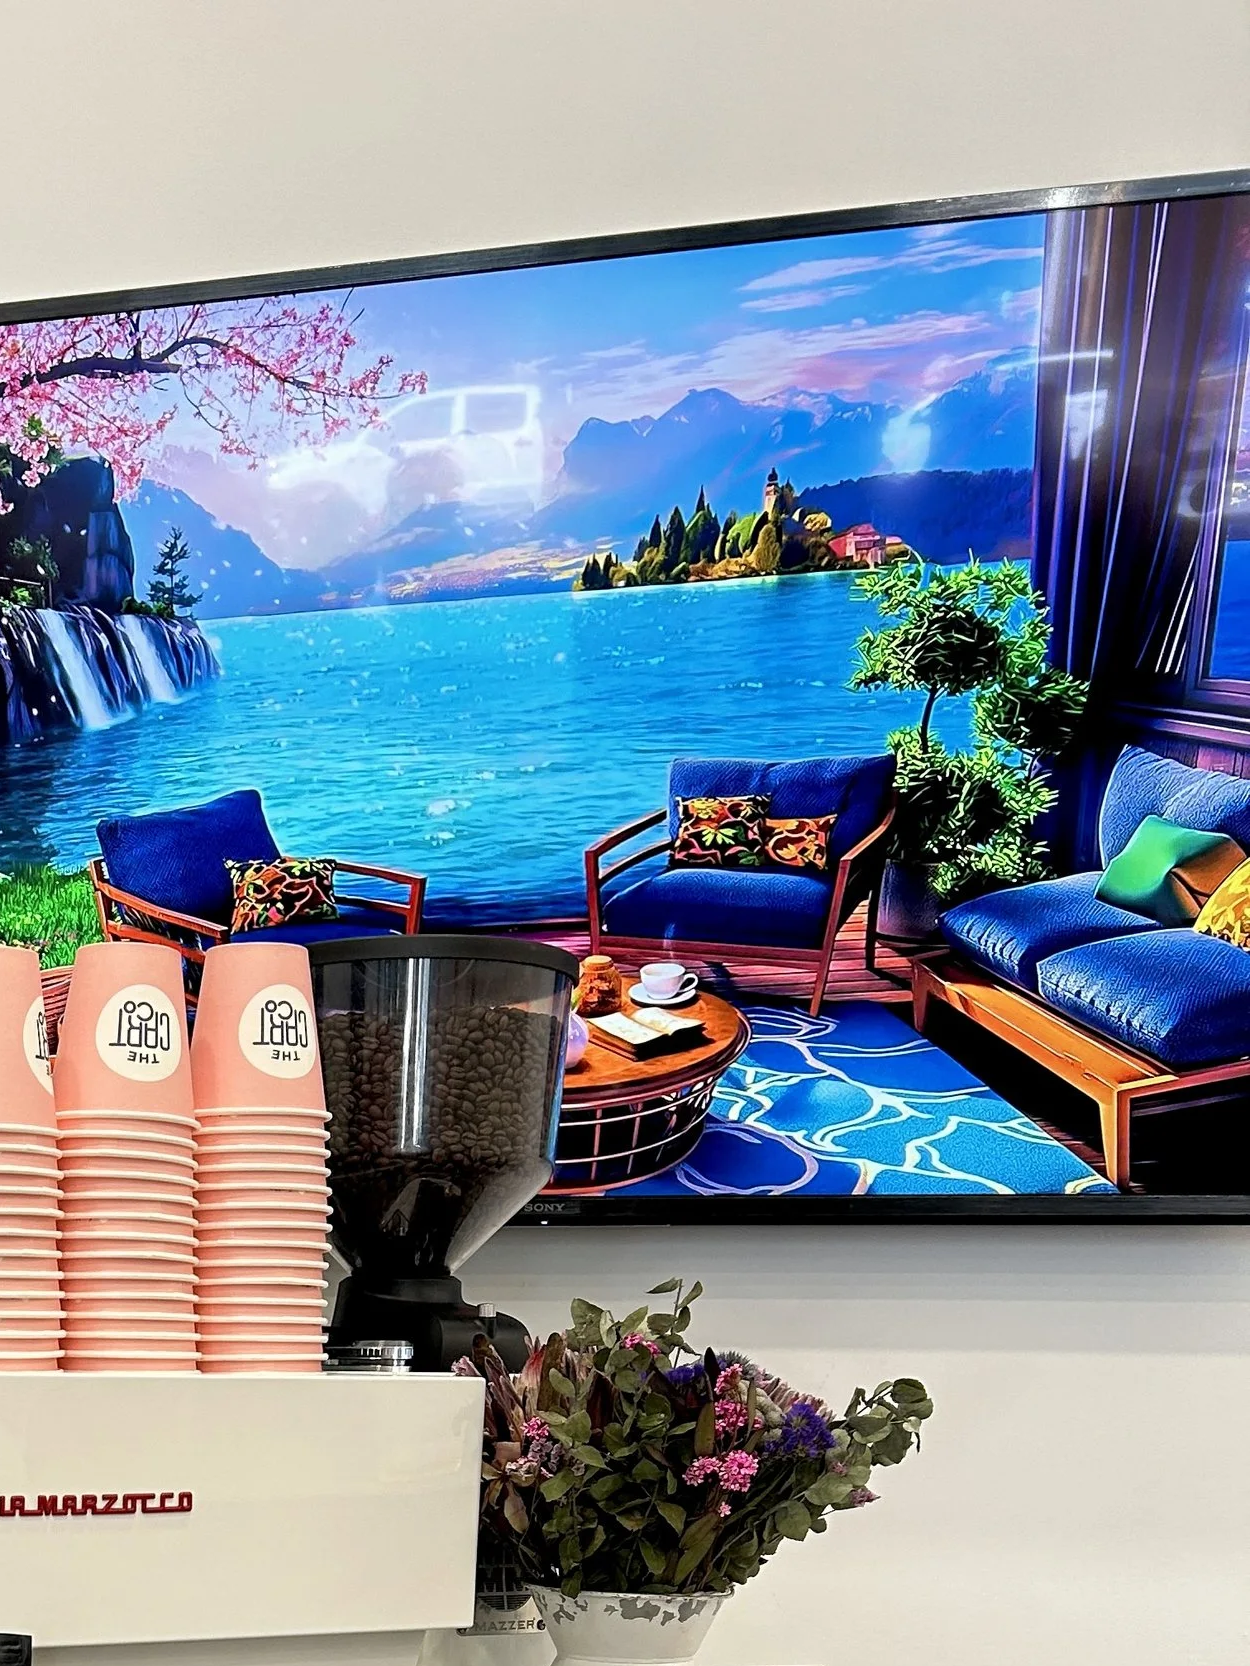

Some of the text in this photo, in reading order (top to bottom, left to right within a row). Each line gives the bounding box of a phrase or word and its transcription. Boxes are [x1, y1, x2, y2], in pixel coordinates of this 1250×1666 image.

[123, 1000, 154, 1022] Co
[264, 999, 293, 1020] Co
[108, 1007, 170, 1051] CART
[252, 1007, 308, 1048] CART
[127, 1051, 160, 1064] THE
[271, 1049, 301, 1061] THE
[523, 1203, 565, 1212] SONY
